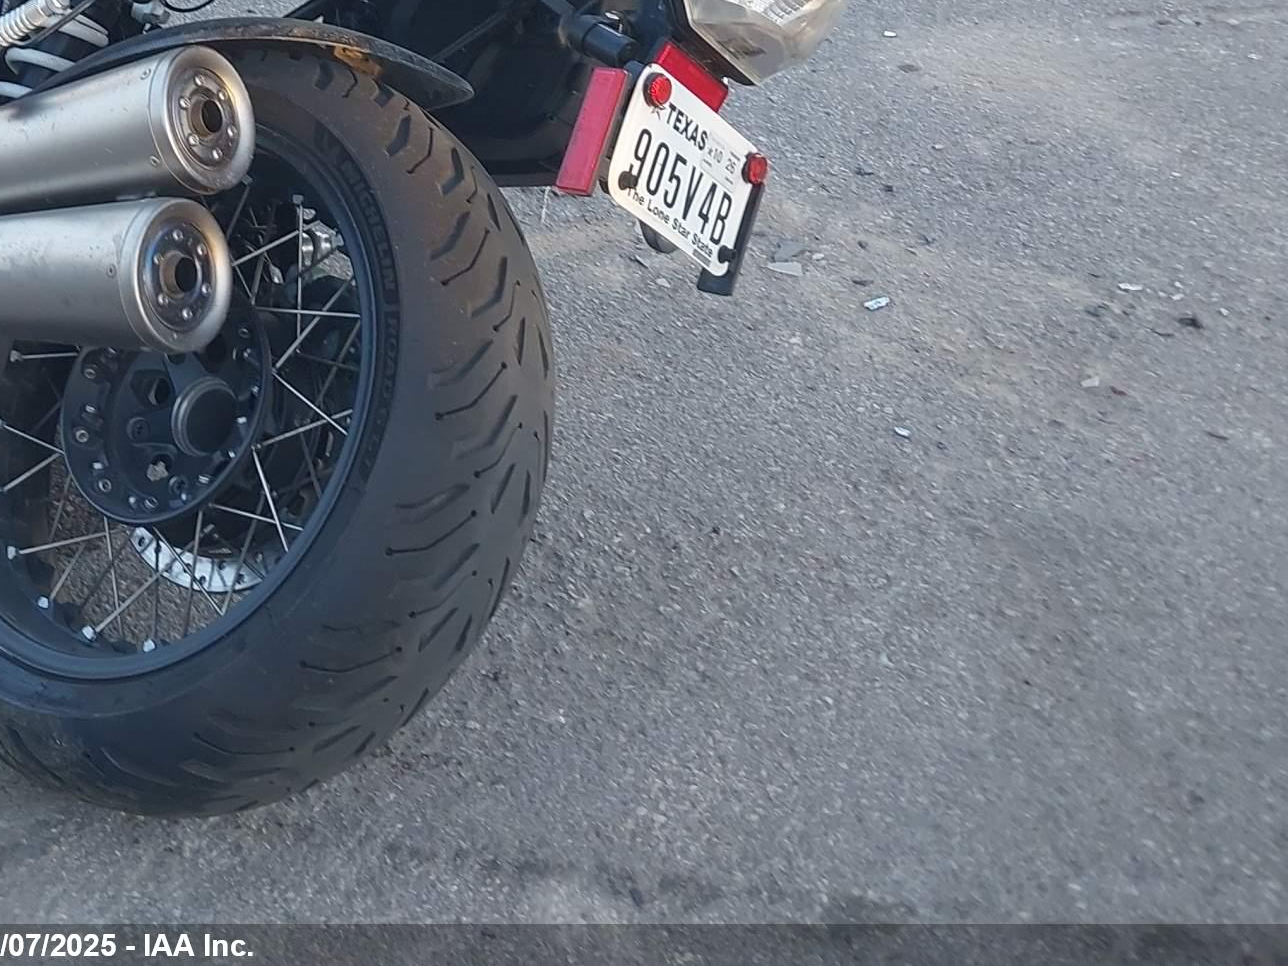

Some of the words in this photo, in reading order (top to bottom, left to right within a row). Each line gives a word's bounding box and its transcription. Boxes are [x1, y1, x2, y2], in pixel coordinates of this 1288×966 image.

[664, 102, 708, 151] TEXAS
[625, 128, 733, 245] 905V4B
[647, 199, 671, 225] Lone
[671, 216, 691, 240] Star
[691, 232, 714, 258] State
